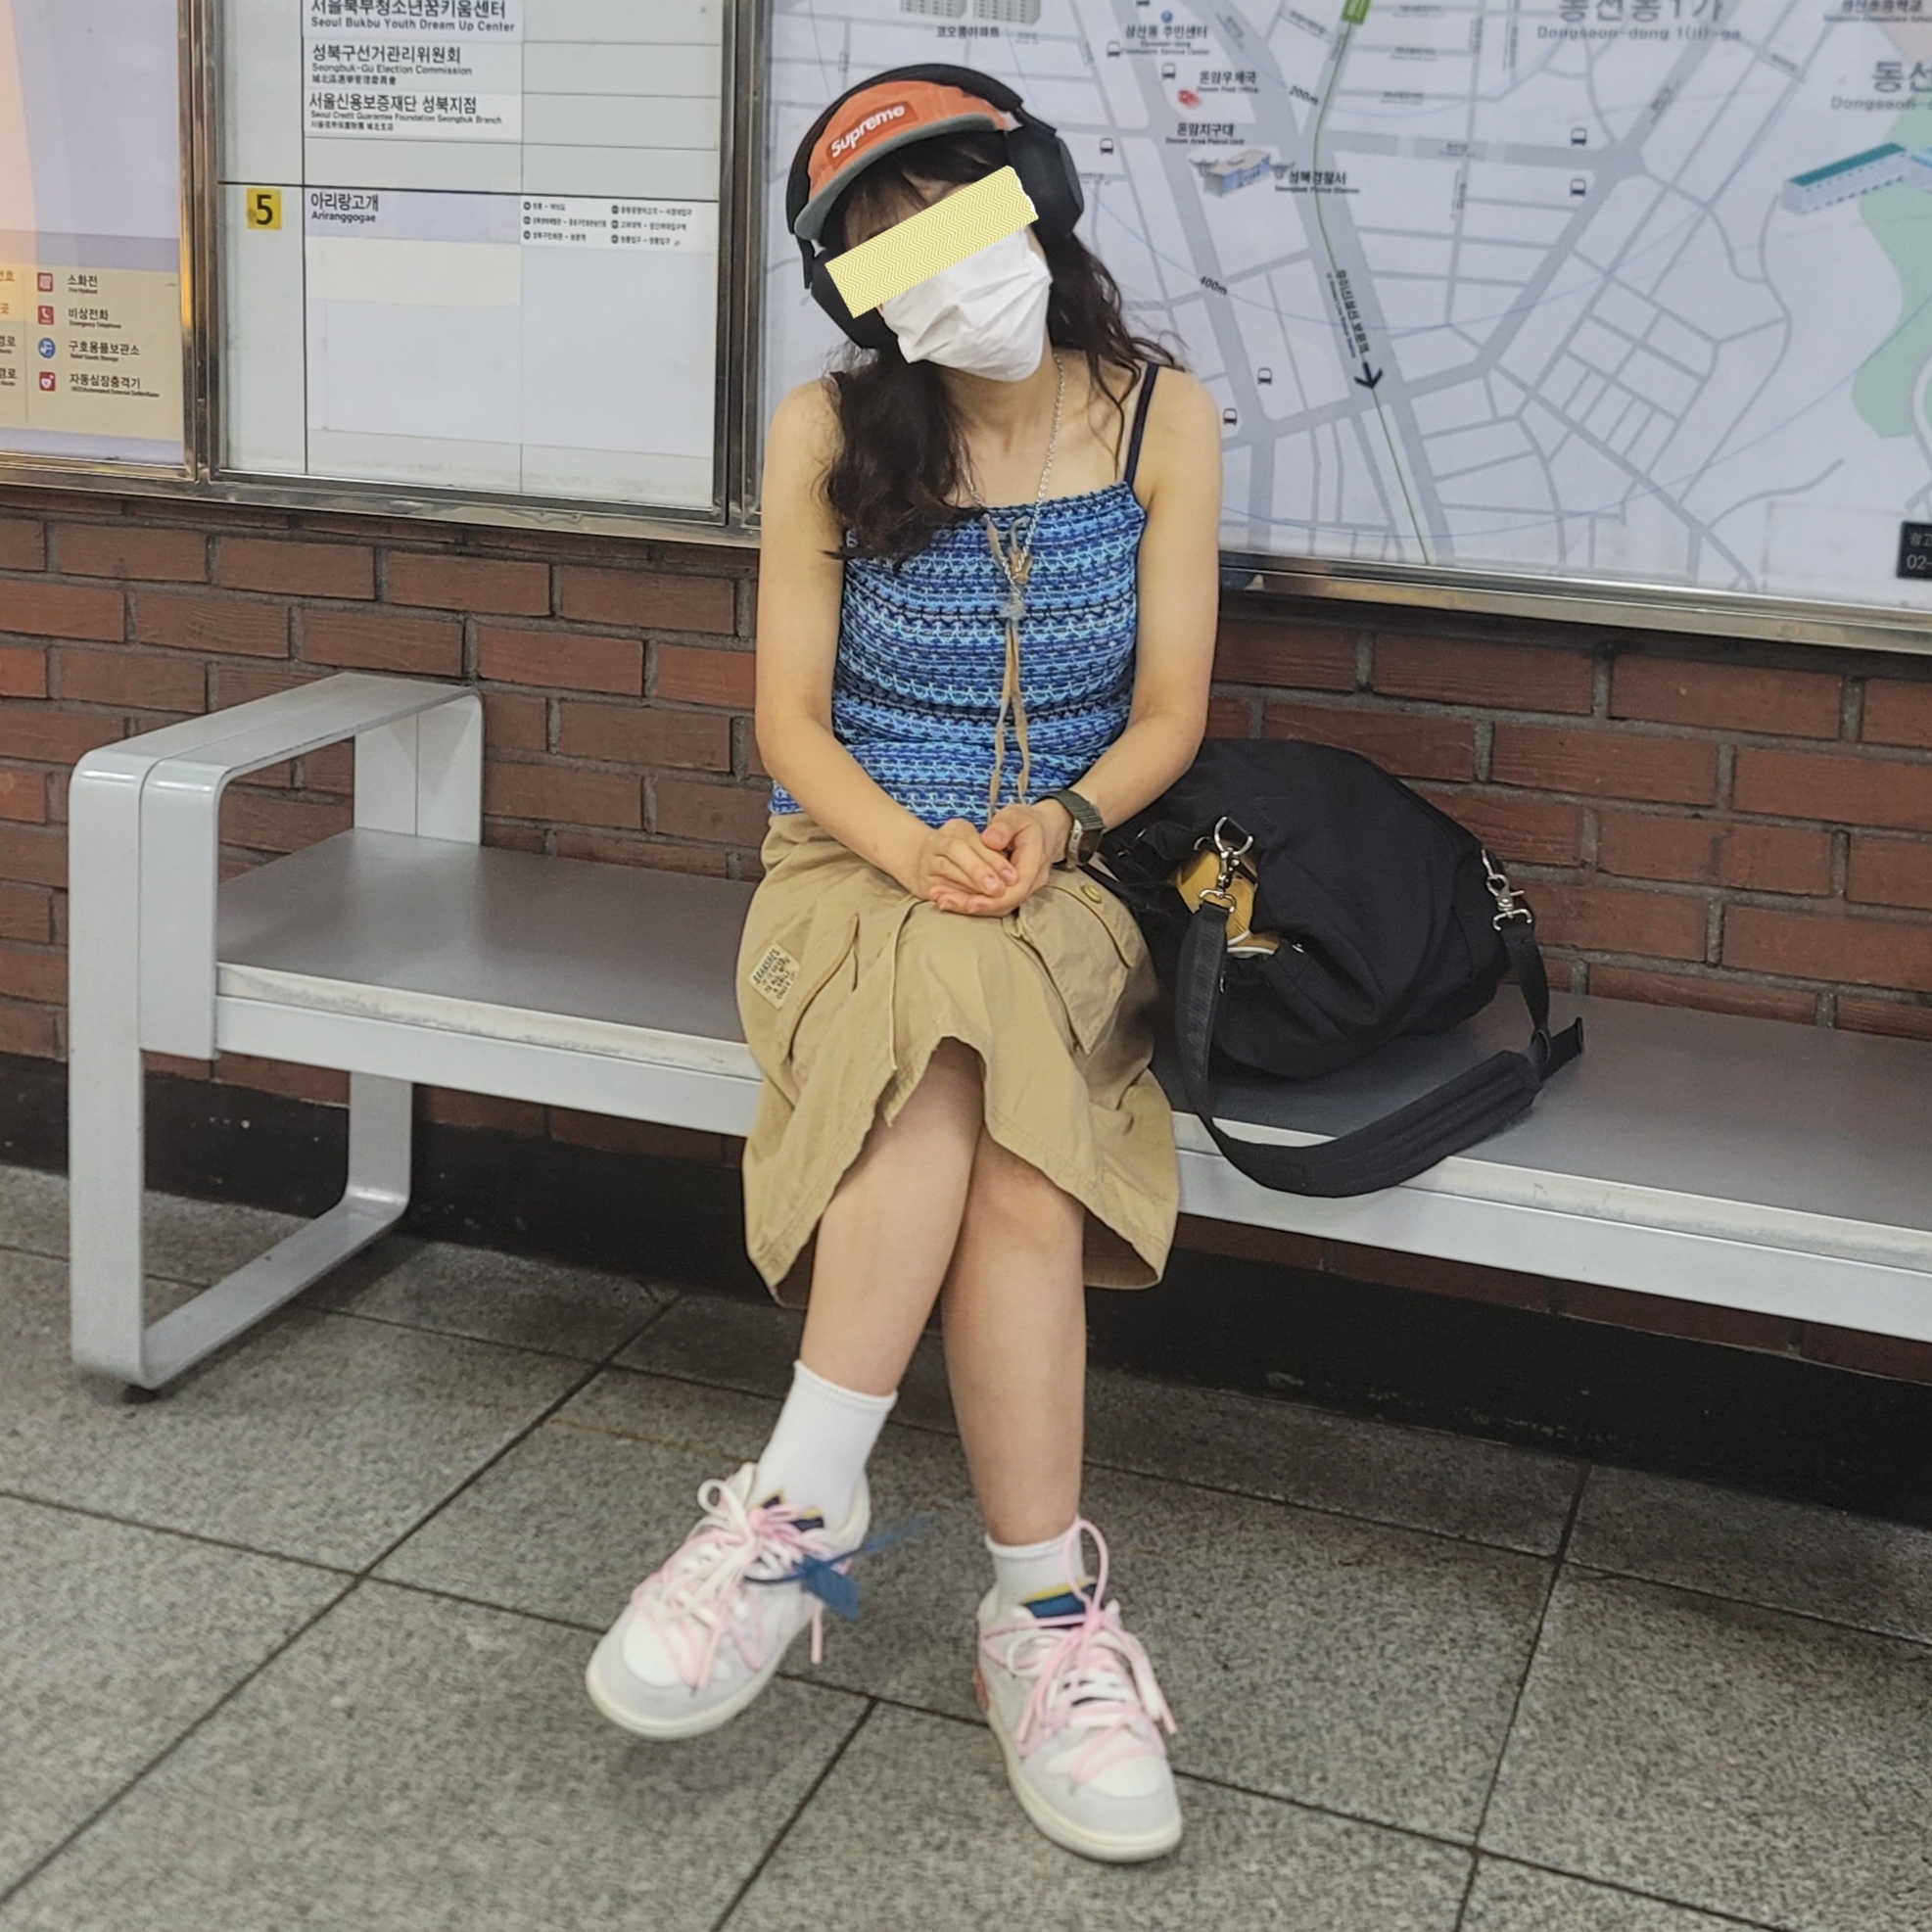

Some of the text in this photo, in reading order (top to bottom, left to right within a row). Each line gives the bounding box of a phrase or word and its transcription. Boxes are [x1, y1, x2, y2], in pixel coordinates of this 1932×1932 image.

[311, 17, 514, 32] Seoul Bukbu Youth Dream Up Center
[1162, 25, 1207, 39] 주민센터
[312, 44, 460, 65] 성북구선거관리위원회
[312, 63, 472, 75] Seongbuk-Gu Election Commission
[1200, 71, 1256, 85] 돈암우체국
[1289, 85, 1319, 106] 200m
[309, 92, 476, 115] 서울신용보증재단 성북지점
[395, 114, 435, 123] Foundation
[830, 105, 906, 158] Supreme
[1177, 122, 1234, 137] 돈암지구대
[1289, 170, 1346, 185] 성북경찰서
[256, 194, 273, 225] 5
[310, 193, 379, 212] 아리랑고개
[311, 211, 376, 223] Ariranggogae
[68, 274, 98, 288] 소화전
[1200, 276, 1228, 295] 400m
[69, 307, 109, 321] 비상전화
[69, 340, 140, 355] 구호용품보관소
[70, 373, 140, 389] 자동심장충격기
